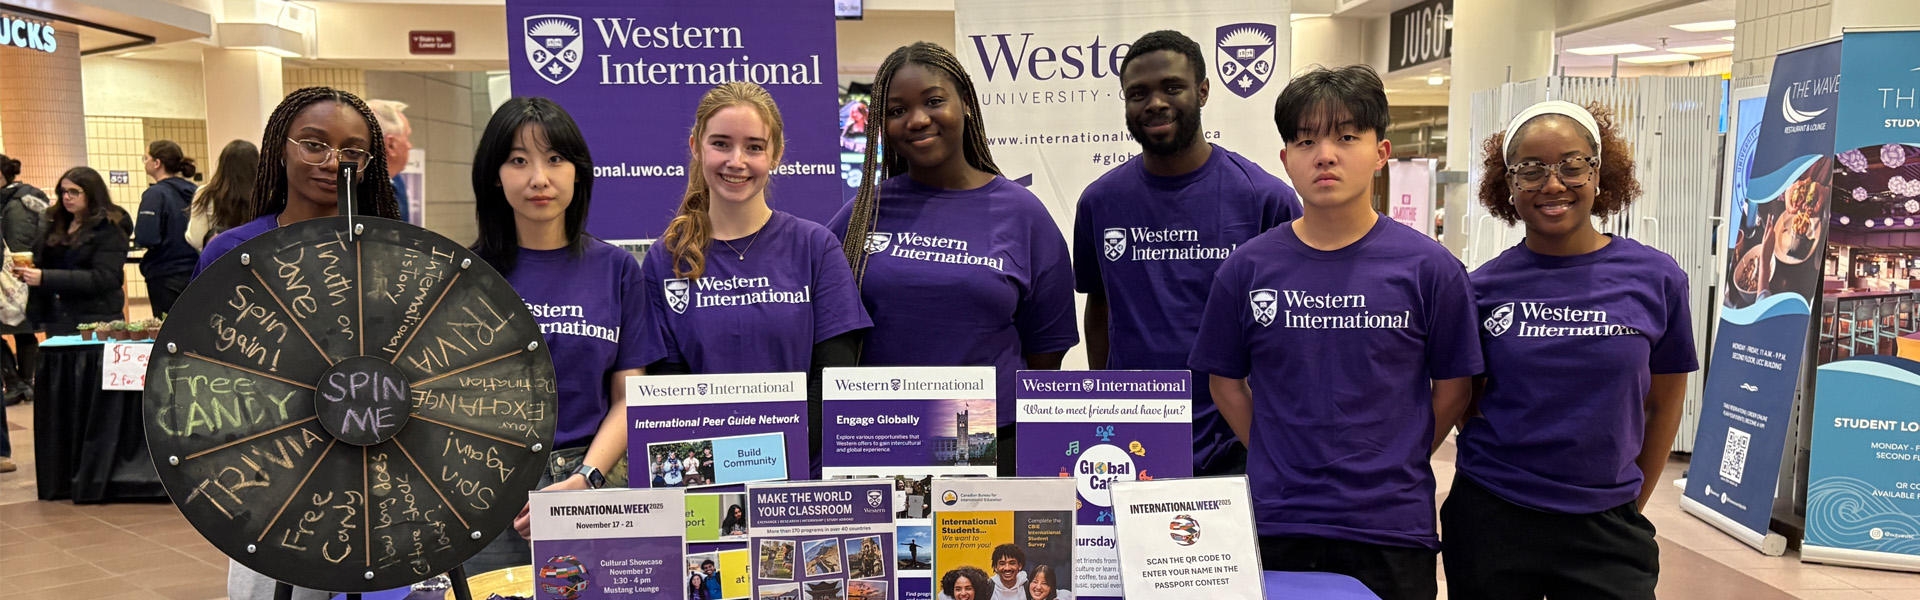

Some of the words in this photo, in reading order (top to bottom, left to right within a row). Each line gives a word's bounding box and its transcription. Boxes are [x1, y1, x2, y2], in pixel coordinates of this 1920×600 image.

[593, 17, 744, 49] Western
[1401, 3, 1444, 66] JUGO
[598, 54, 823, 85] International
[1792, 80, 1811, 99] THE
[1813, 74, 1841, 96] WAVE
[982, 90, 1100, 106] UNIVERSITY
[896, 232, 968, 252] Western
[1130, 227, 1199, 243] Western
[890, 244, 1004, 272] International
[315, 230, 353, 306] Truth
[337, 315, 354, 340] or
[696, 274, 770, 291] Western
[696, 286, 811, 308] International
[1283, 290, 1366, 308] Western
[229, 285, 288, 343] Spin
[524, 299, 584, 319] estern
[1520, 302, 1608, 323] Western
[1284, 309, 1410, 330] International
[407, 296, 515, 374] TRIVIA
[113, 344, 133, 365] $5
[110, 373, 119, 386] 2
[165, 363, 256, 396] Free
[322, 371, 406, 402] SPIN
[835, 379, 889, 391] Western
[902, 378, 984, 391] International
[1022, 379, 1081, 392] Western
[1096, 379, 1186, 392] International
[638, 385, 695, 397] Western
[710, 381, 794, 395] International
[156, 390, 297, 437] CANDY
[411, 389, 545, 422] EXCHANGE
[1023, 404, 1053, 415] Want
[1054, 406, 1064, 415] to
[1066, 406, 1088, 415] meet
[1088, 404, 1119, 419] friends
[1120, 405, 1139, 415] and
[1140, 404, 1162, 415] have
[1163, 405, 1186, 419] fun?
[341, 406, 396, 443] ME
[635, 417, 700, 429] International
[702, 416, 725, 427] Peer
[727, 416, 756, 426] Guide
[758, 414, 800, 425] Network
[836, 415, 875, 426] Engage
[877, 414, 920, 426] Globally
[1834, 417, 1898, 431] STUDENT
[738, 448, 761, 458] Build
[1871, 442, 1909, 451] MONDAY
[724, 456, 777, 468] Community
[1876, 451, 1911, 460] SECOND
[185, 427, 324, 520] TRIVIA
[757, 493, 788, 504] MAKE
[790, 492, 812, 503] THE
[813, 491, 852, 502] WORLD
[1872, 490, 1915, 499] AVAILABLE
[758, 506, 786, 517] YOUR
[788, 504, 852, 516] CLASSROOM
[576, 521, 611, 530] November
[625, 520, 633, 528] 21
[960, 542, 976, 550] from
[600, 559, 628, 567] Cultural
[629, 558, 663, 566] Showcase
[1146, 557, 1168, 565] SCAN
[1169, 556, 1184, 564] THE
[609, 568, 644, 576] November
[645, 567, 653, 575] 17
[1168, 568, 1190, 576] YOUR
[1191, 567, 1213, 575] NAME
[604, 586, 633, 595] Mustang
[634, 585, 660, 594] Lounge
[1154, 580, 1193, 589] PASSPORT
[1195, 578, 1230, 586] CONTEST
